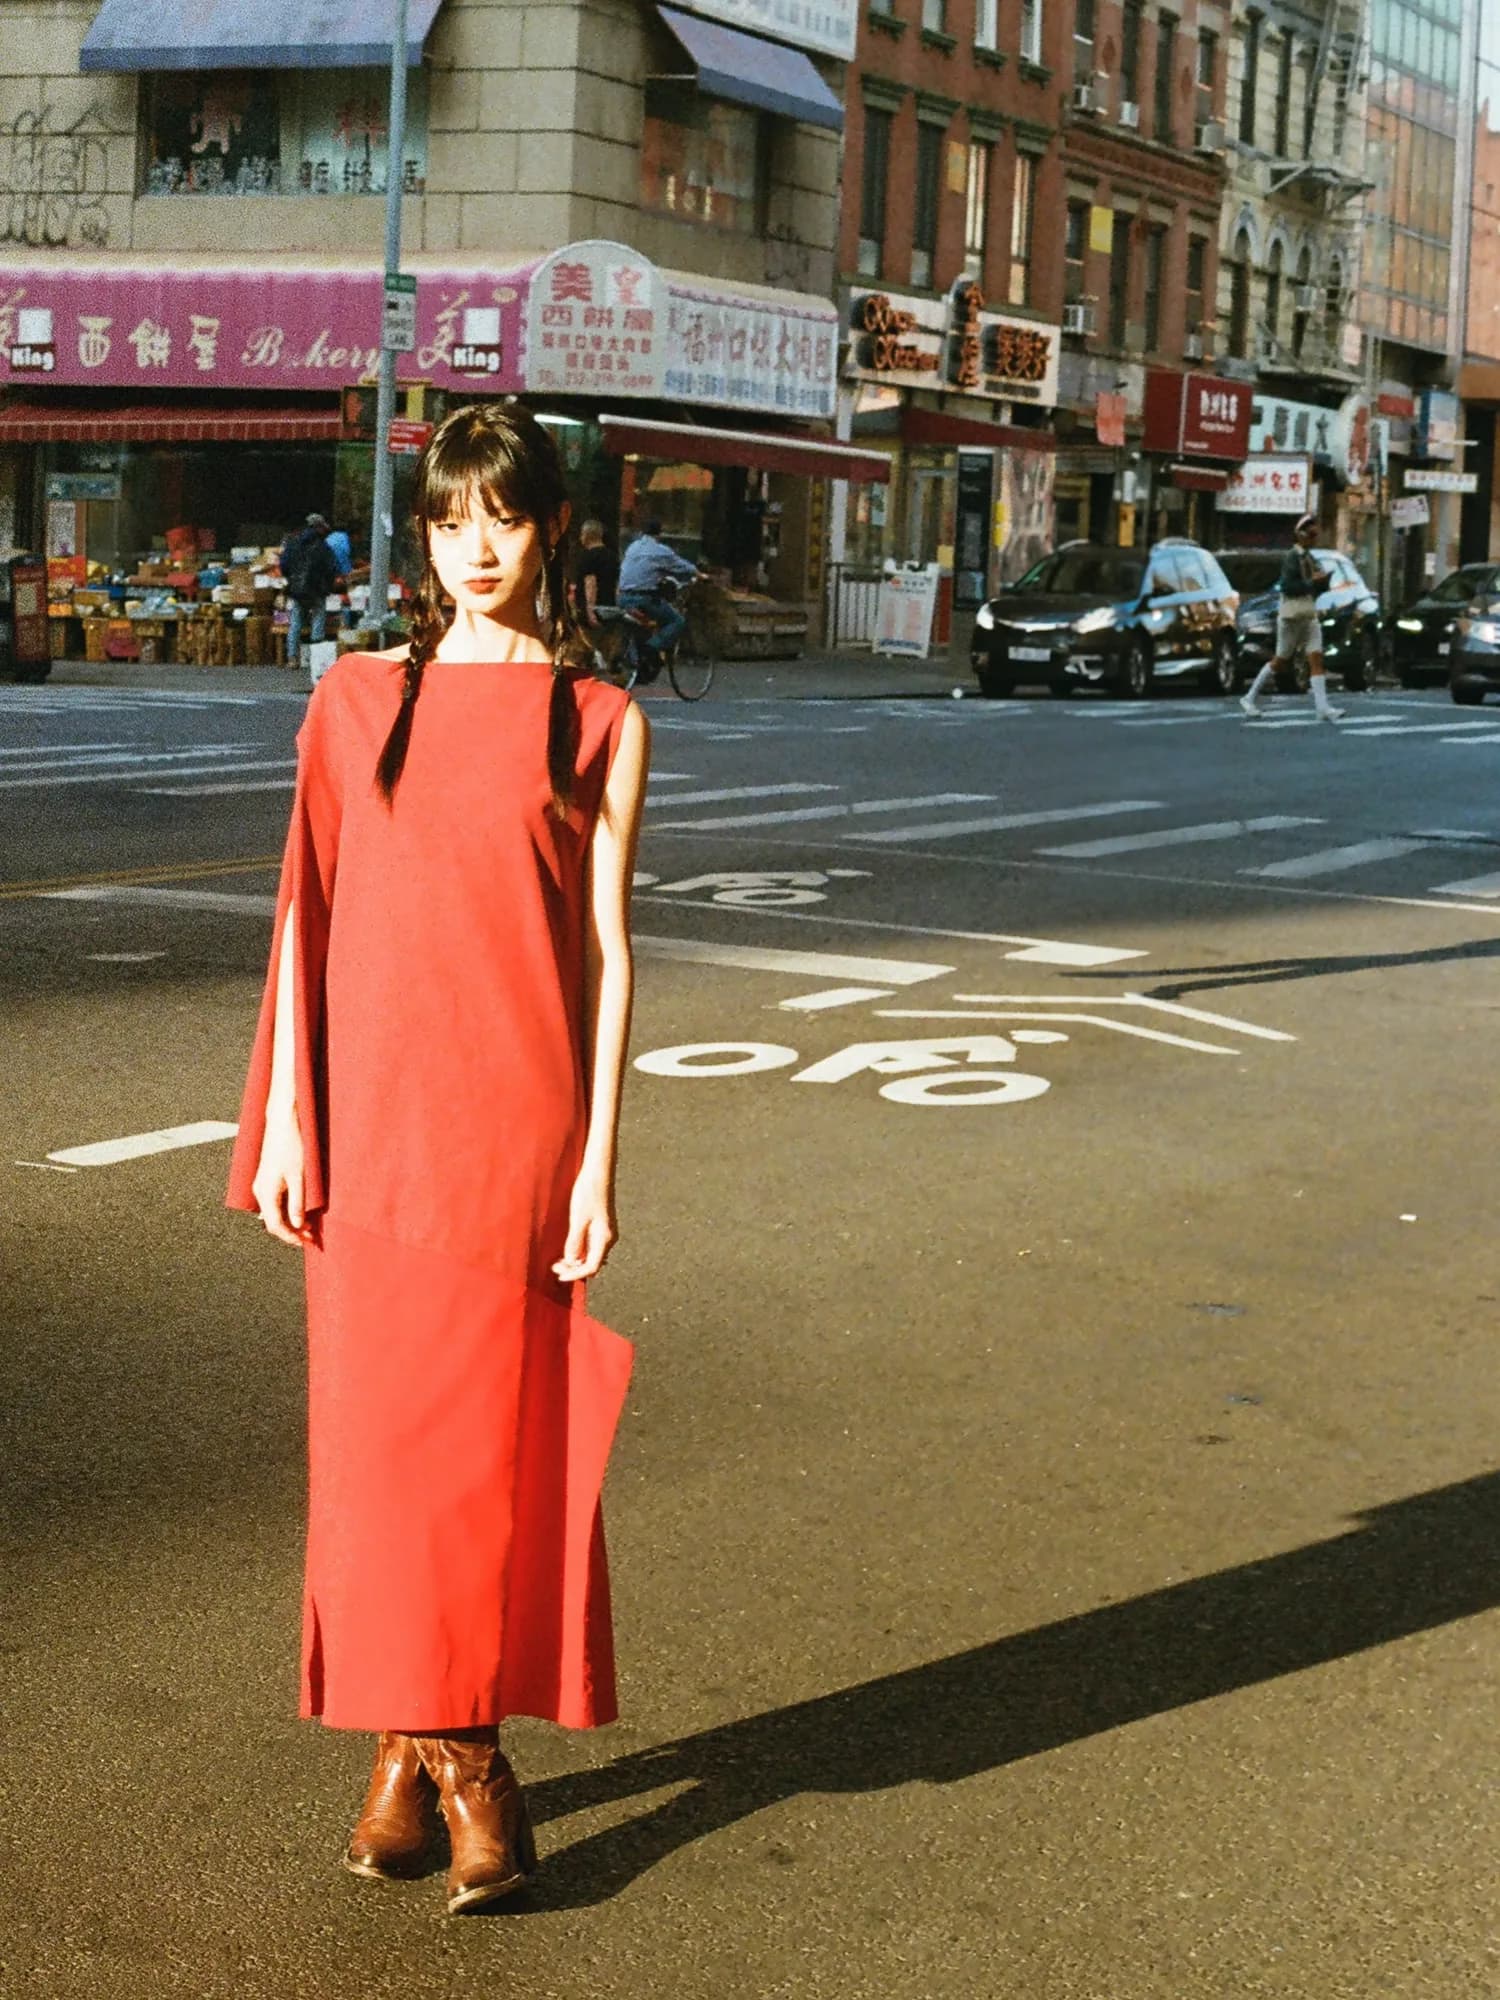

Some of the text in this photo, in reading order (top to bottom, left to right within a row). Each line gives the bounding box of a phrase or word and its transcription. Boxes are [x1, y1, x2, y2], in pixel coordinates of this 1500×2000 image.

[552, 262, 592, 302] 美
[12, 346, 55, 371] King
[241, 326, 382, 384] Bkery
[453, 346, 500, 372] King
